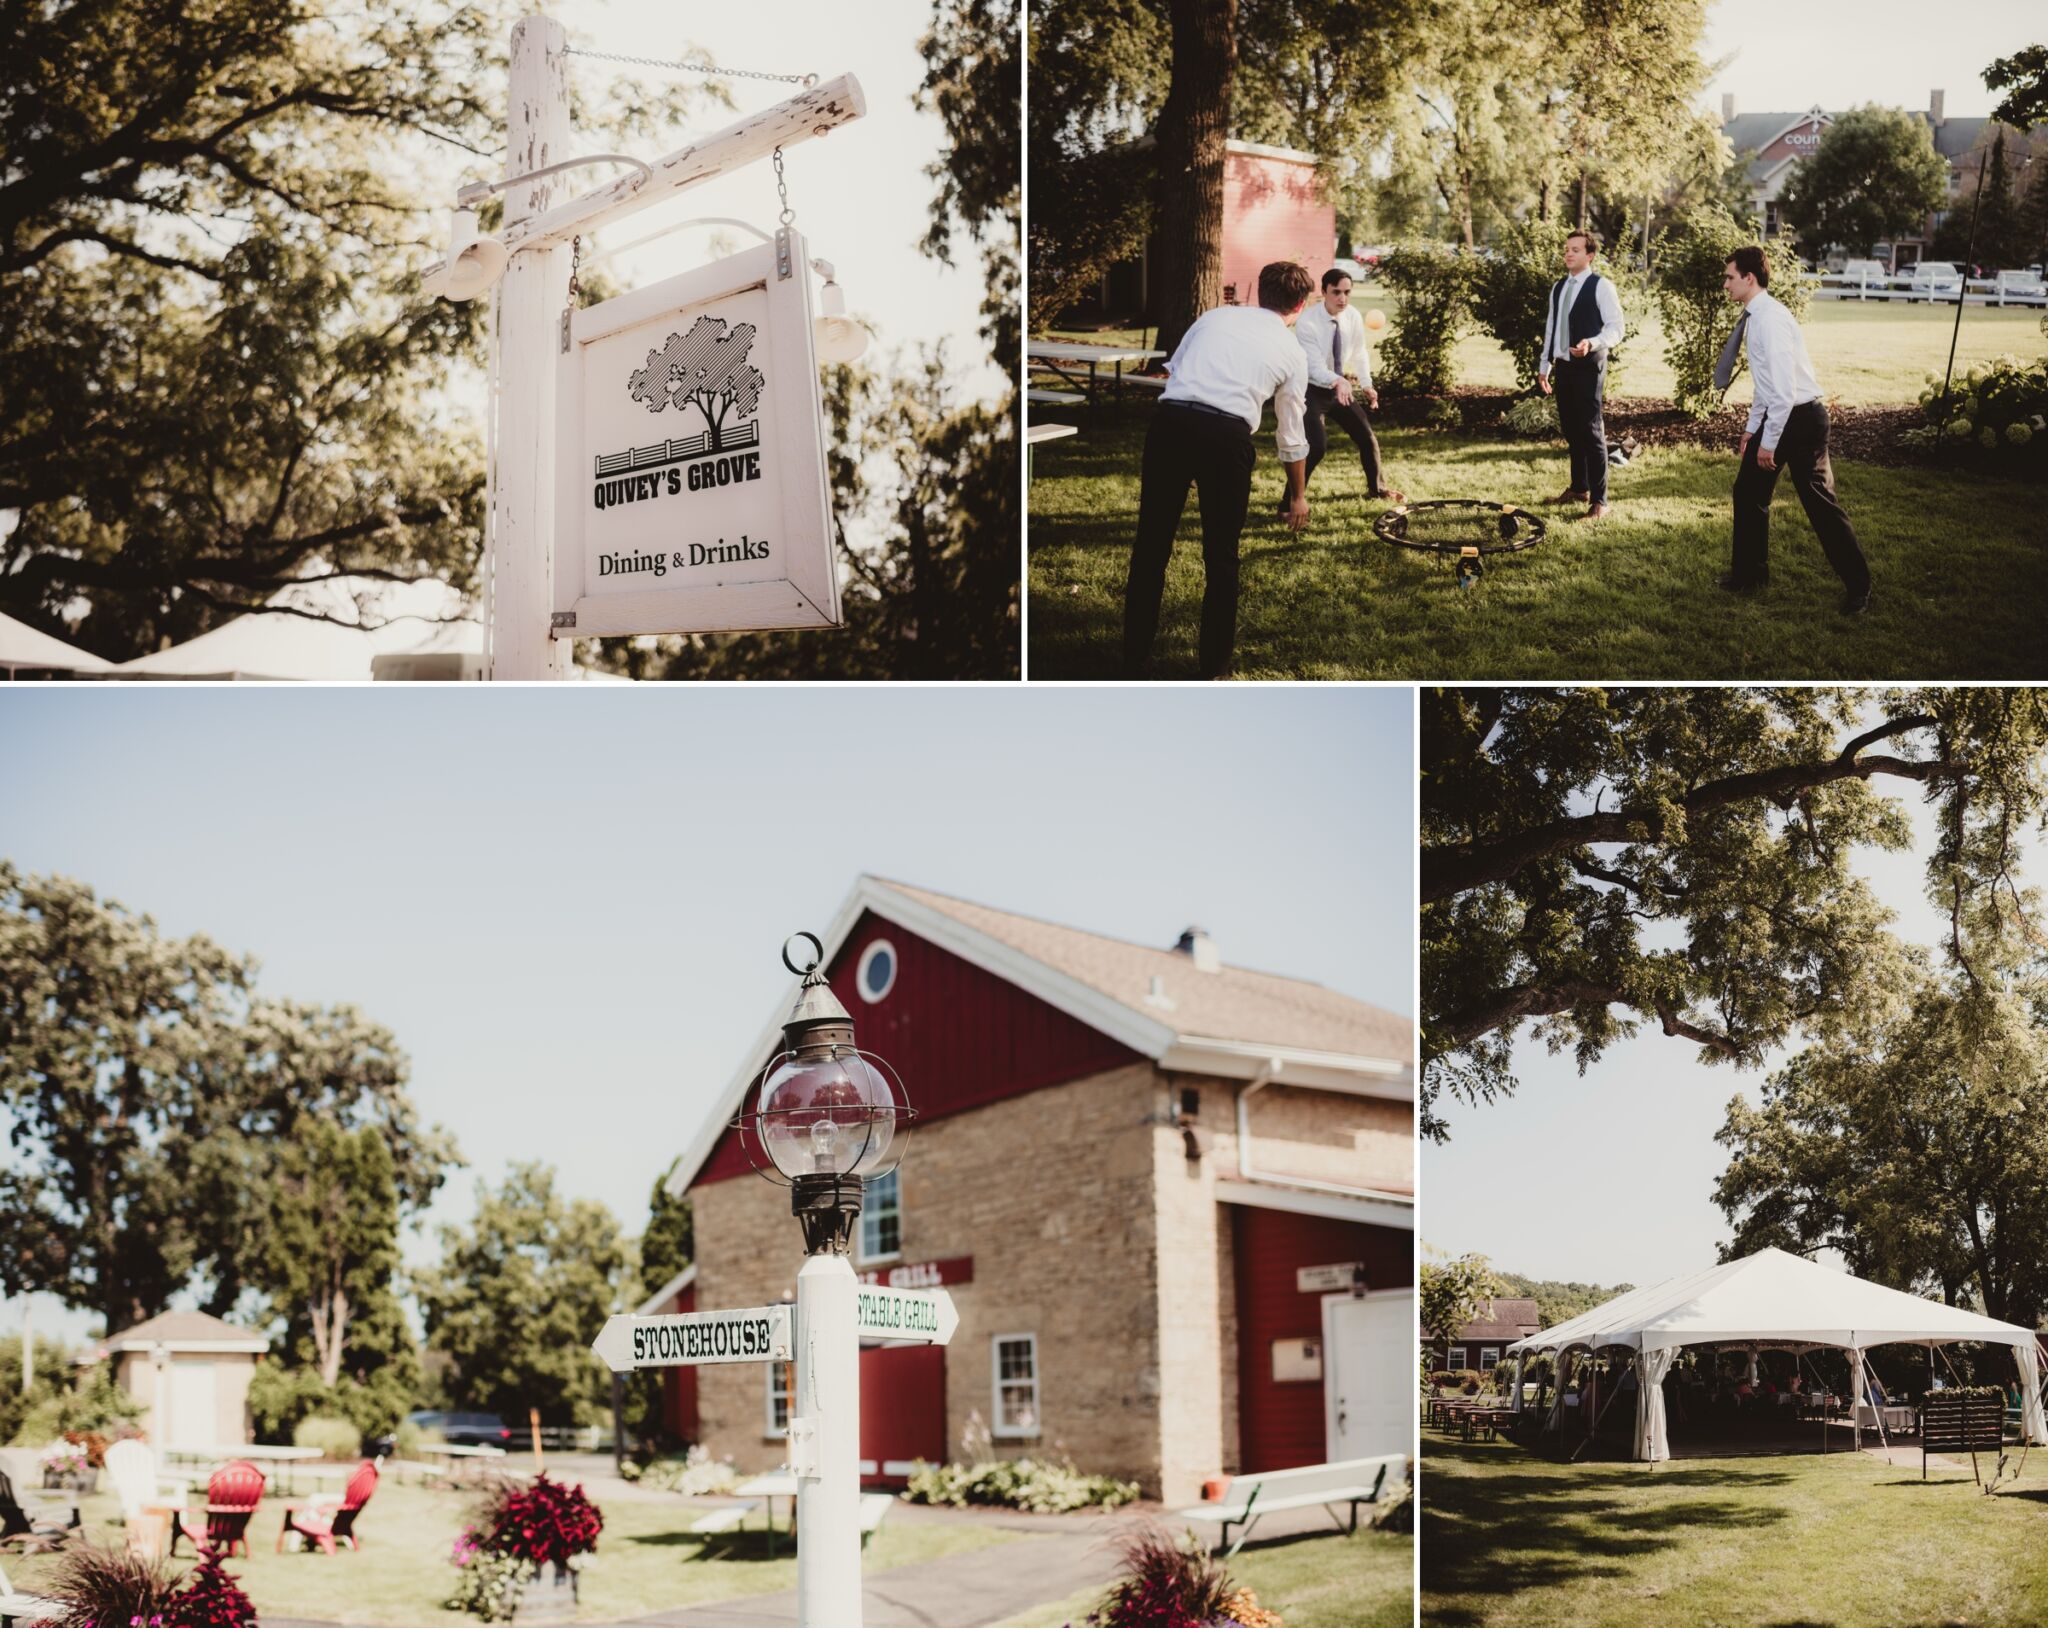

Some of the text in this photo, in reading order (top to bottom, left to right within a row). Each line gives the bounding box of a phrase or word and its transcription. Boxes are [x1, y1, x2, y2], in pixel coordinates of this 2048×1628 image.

[1784, 133, 1821, 145] coun
[594, 451, 761, 510] QUIVEY'S GROVE
[598, 535, 770, 577] Dining & Drinks
[904, 1299, 938, 1332] GRILL
[633, 1318, 771, 1360] STONEHOUSE
